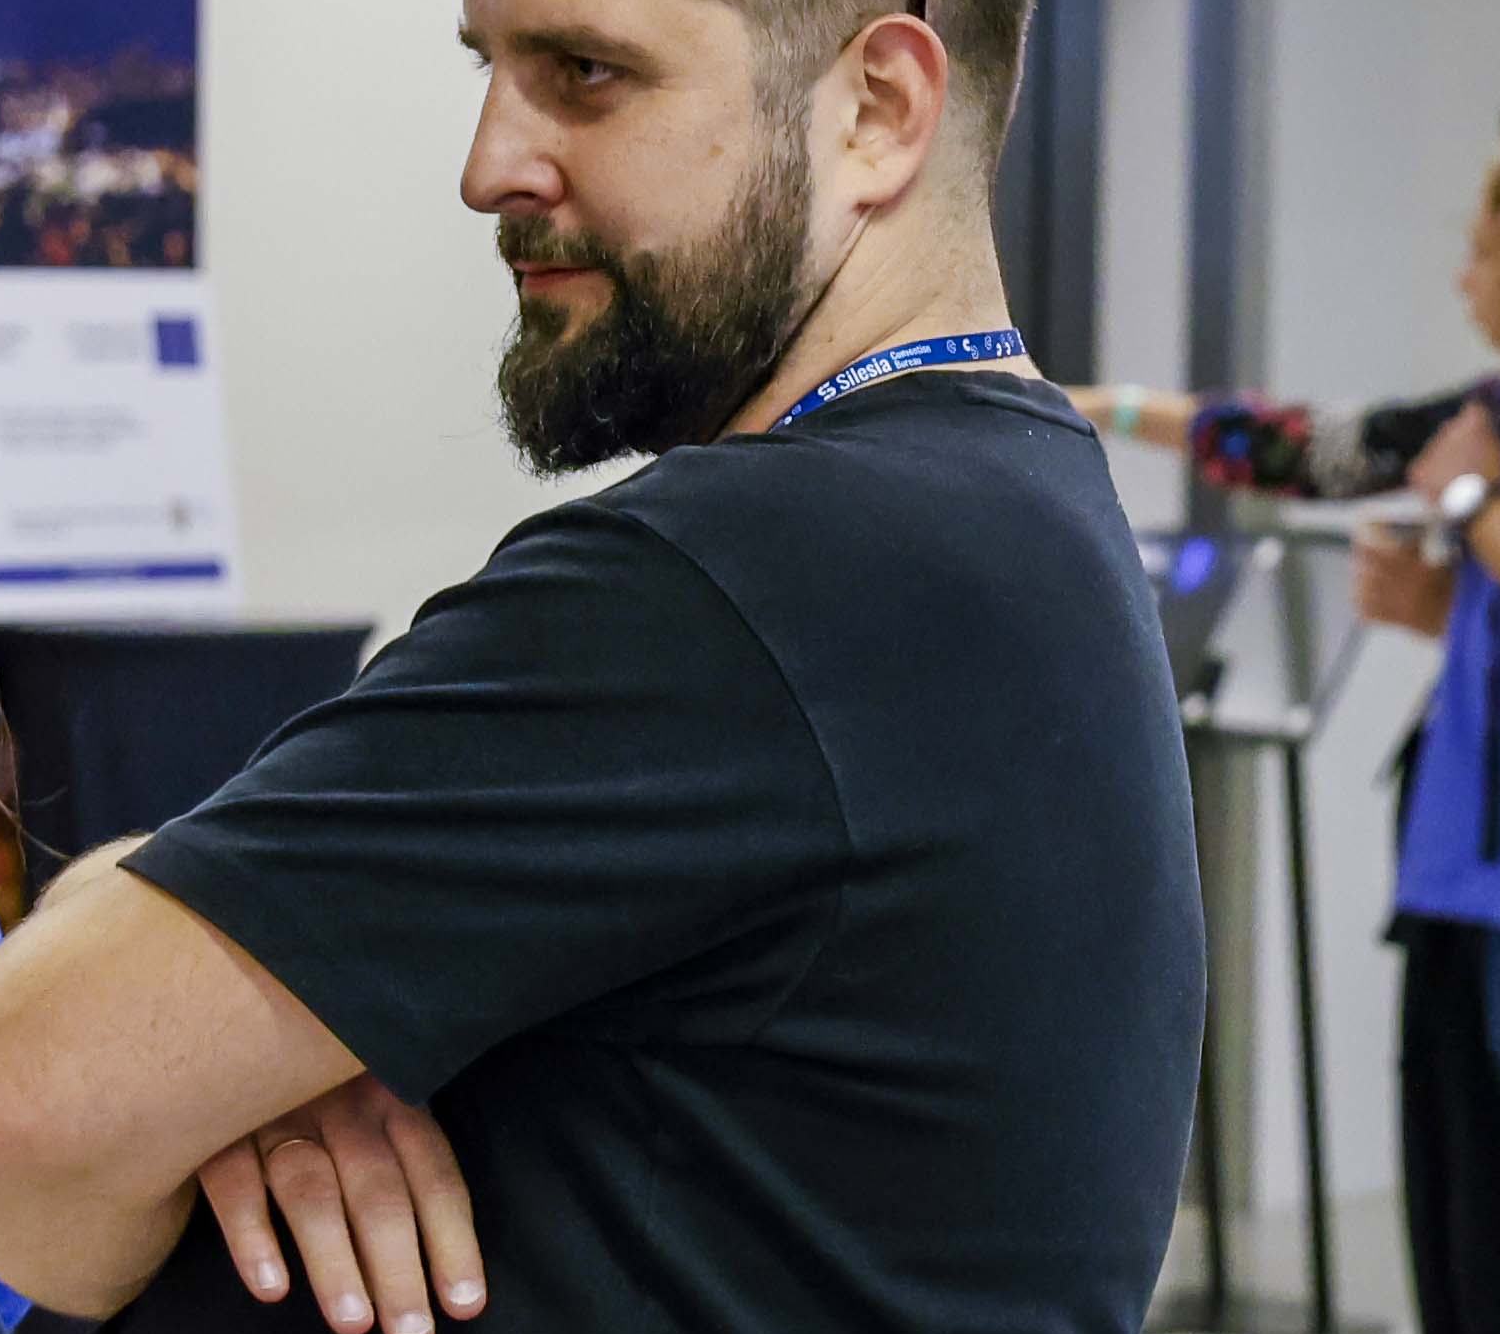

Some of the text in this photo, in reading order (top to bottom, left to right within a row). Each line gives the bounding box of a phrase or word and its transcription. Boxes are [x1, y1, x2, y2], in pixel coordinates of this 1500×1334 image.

[889, 344, 932, 360] Convention
[894, 357, 923, 370] Bureau
[835, 357, 892, 390] Silesia
